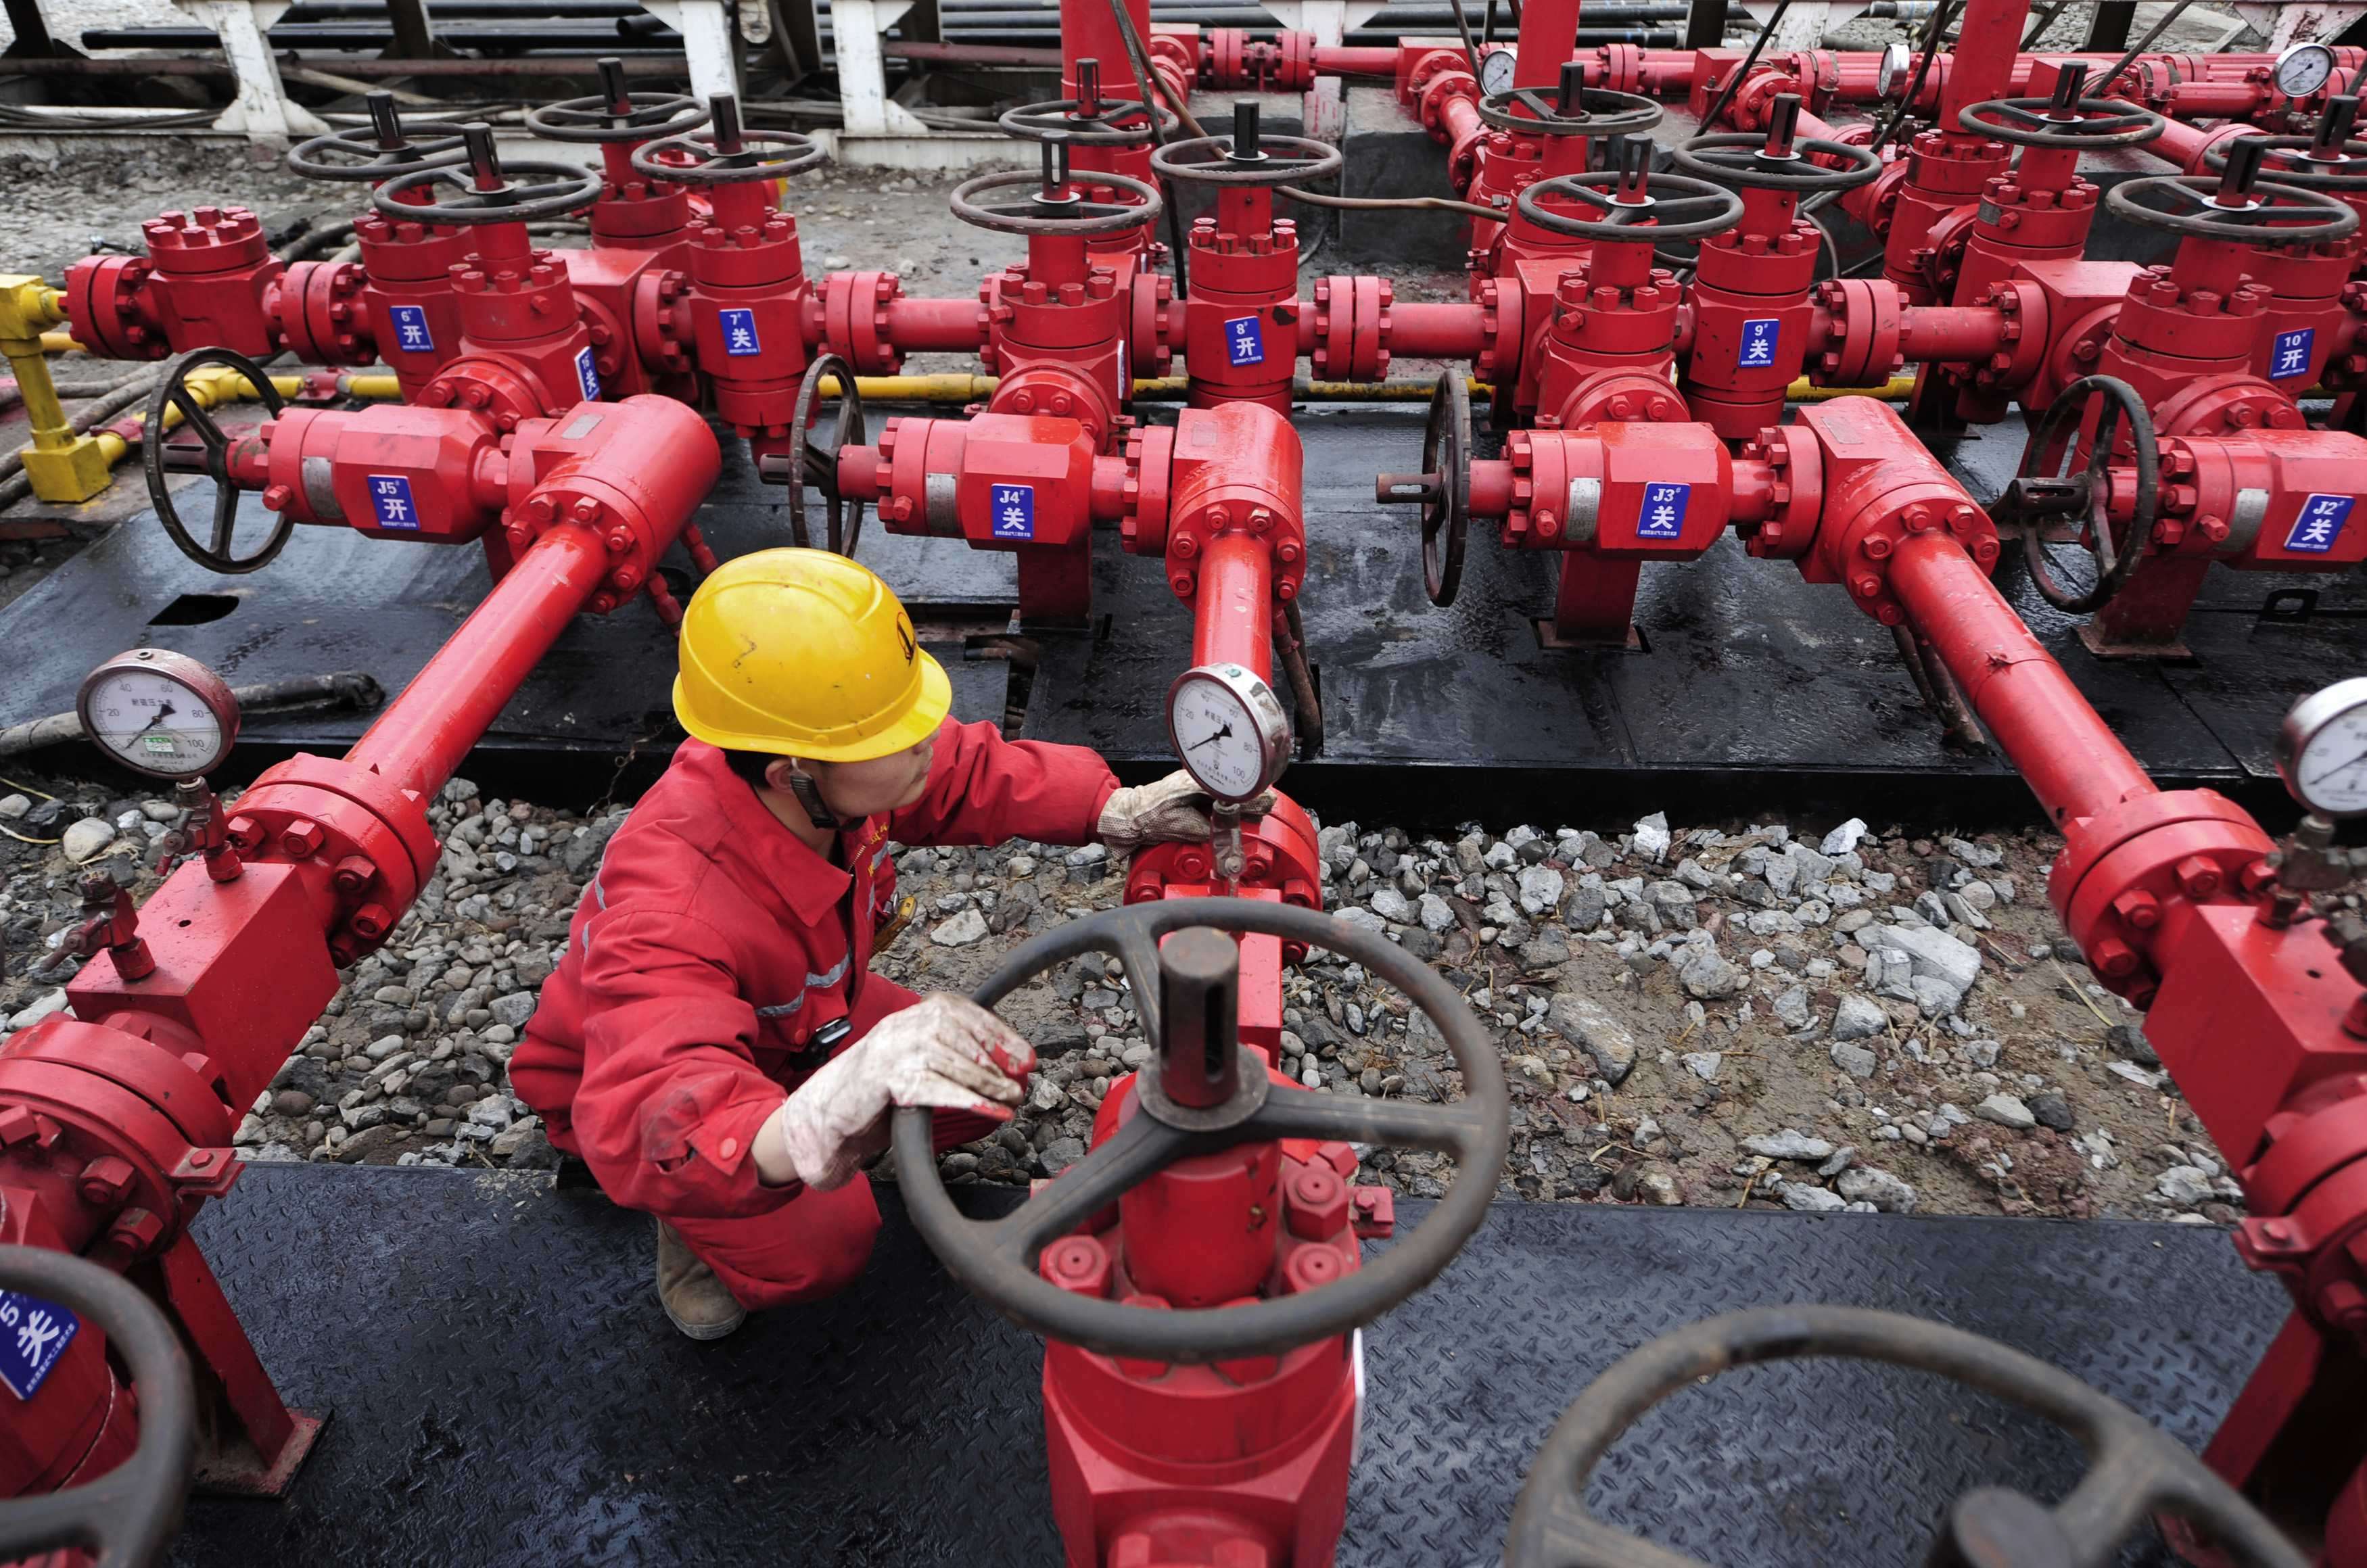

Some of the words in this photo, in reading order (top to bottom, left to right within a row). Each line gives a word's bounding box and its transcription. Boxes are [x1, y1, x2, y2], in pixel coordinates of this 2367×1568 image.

[402, 325, 423, 343] 开
[731, 328, 752, 348] 关
[1236, 337, 1256, 357] 开
[1748, 339, 1769, 359] 关
[2280, 348, 2304, 370] 开
[382, 498, 408, 521] 开
[1002, 506, 1026, 531] 关
[1649, 504, 1675, 529] 关
[2301, 518, 2333, 543] 关
[108, 708, 120, 717] 20
[191, 709, 204, 718] 80
[187, 739, 205, 749] 100
[1232, 765, 1246, 779] 100
[17, 1309, 60, 1368] 关
